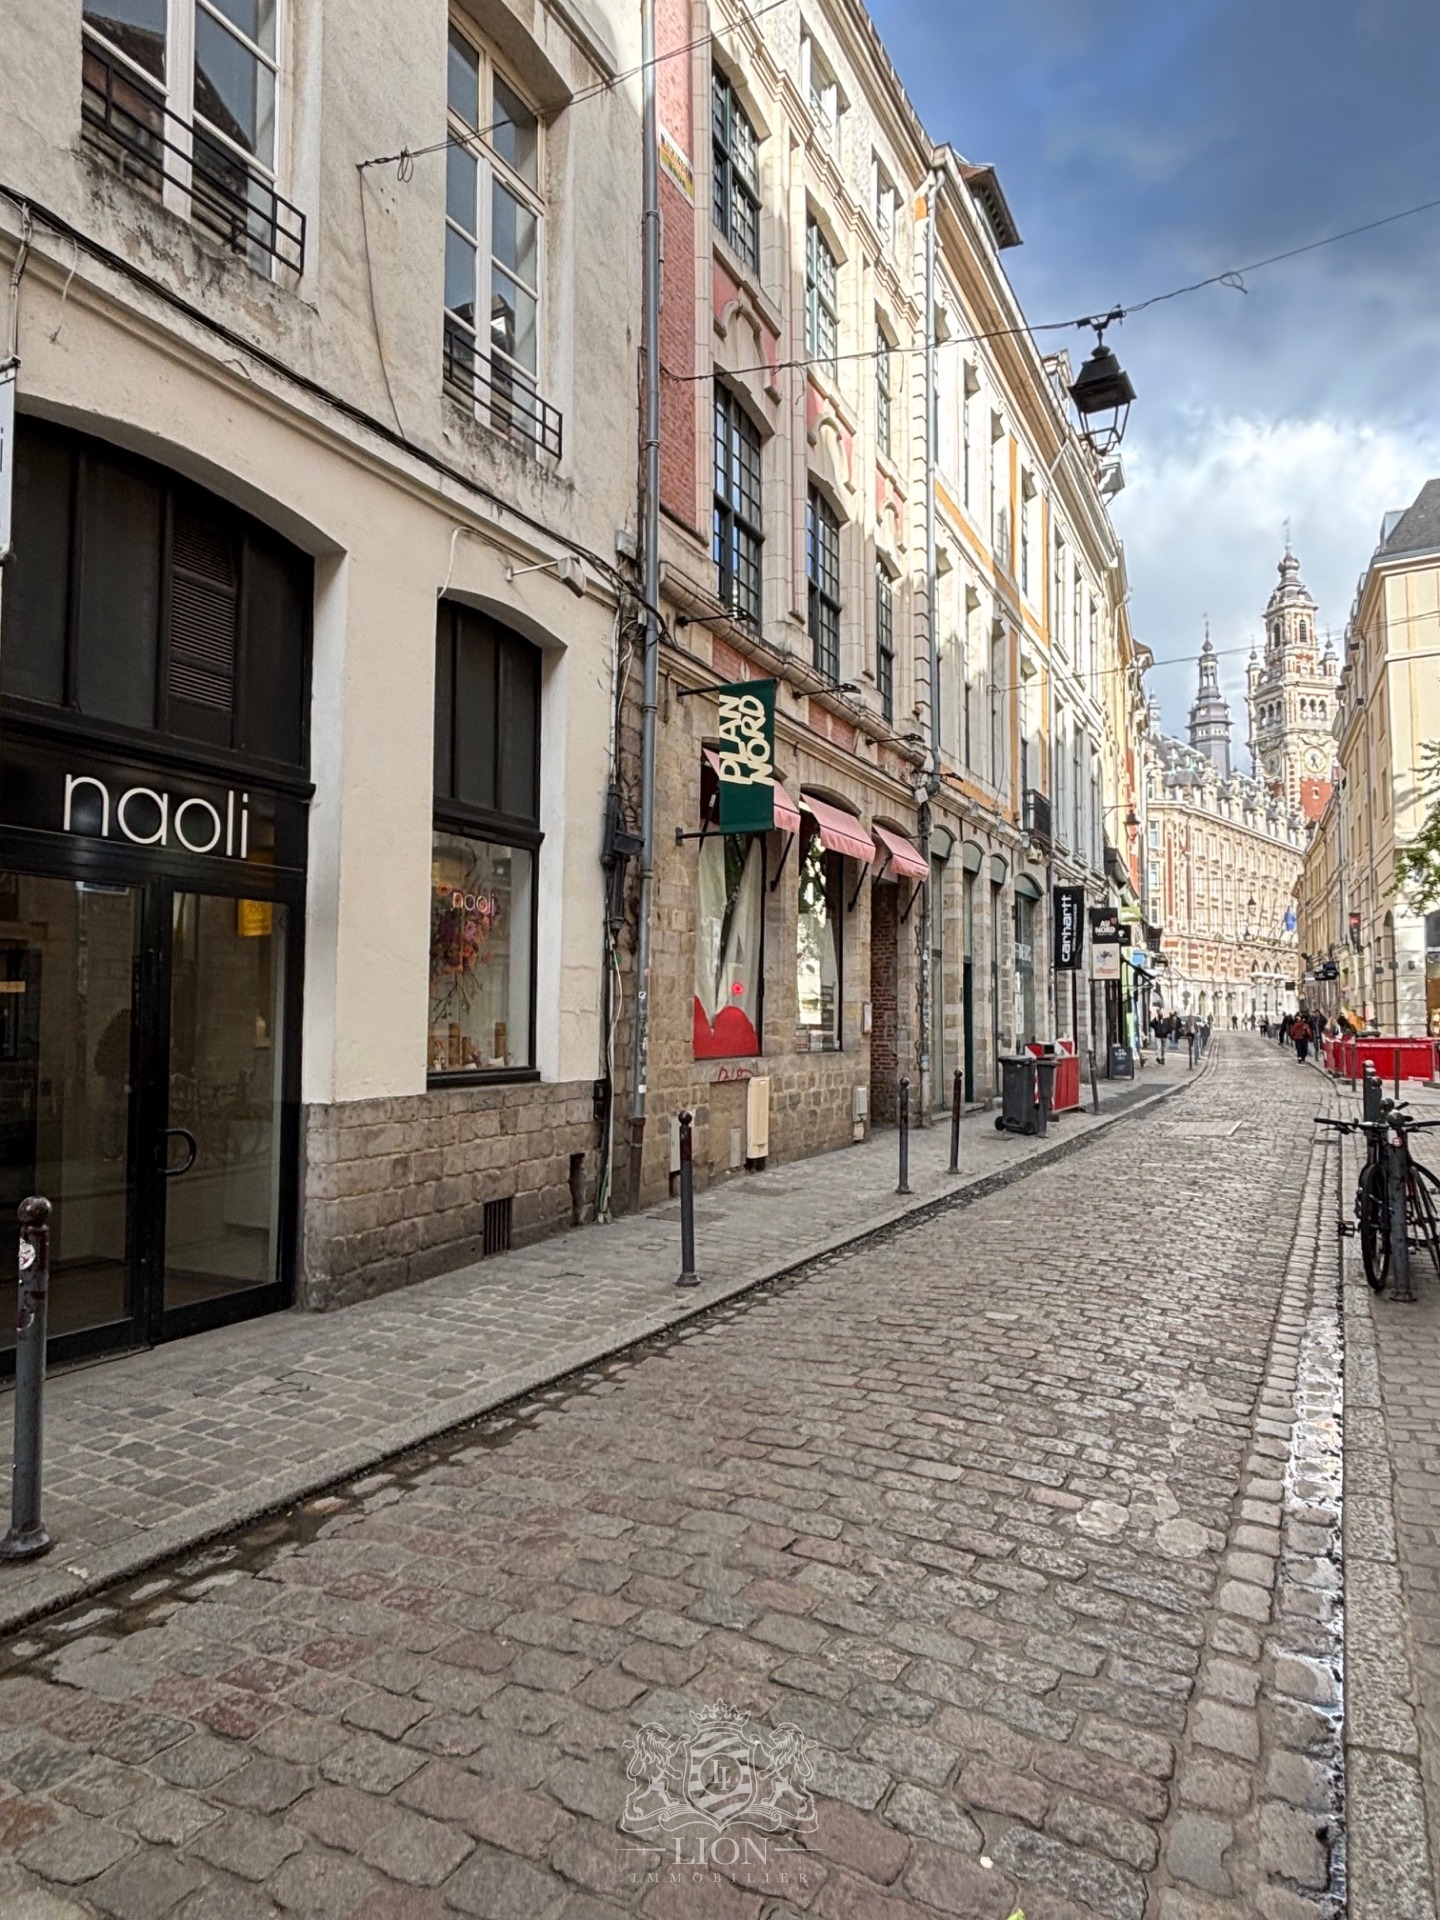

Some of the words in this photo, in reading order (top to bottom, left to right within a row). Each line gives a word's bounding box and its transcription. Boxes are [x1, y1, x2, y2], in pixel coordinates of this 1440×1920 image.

[719, 694, 753, 785] PLAN
[738, 694, 774, 787] NORD
[63, 773, 249, 859] naoli
[452, 891, 495, 917] naoli
[1061, 893, 1072, 963] carhartt
